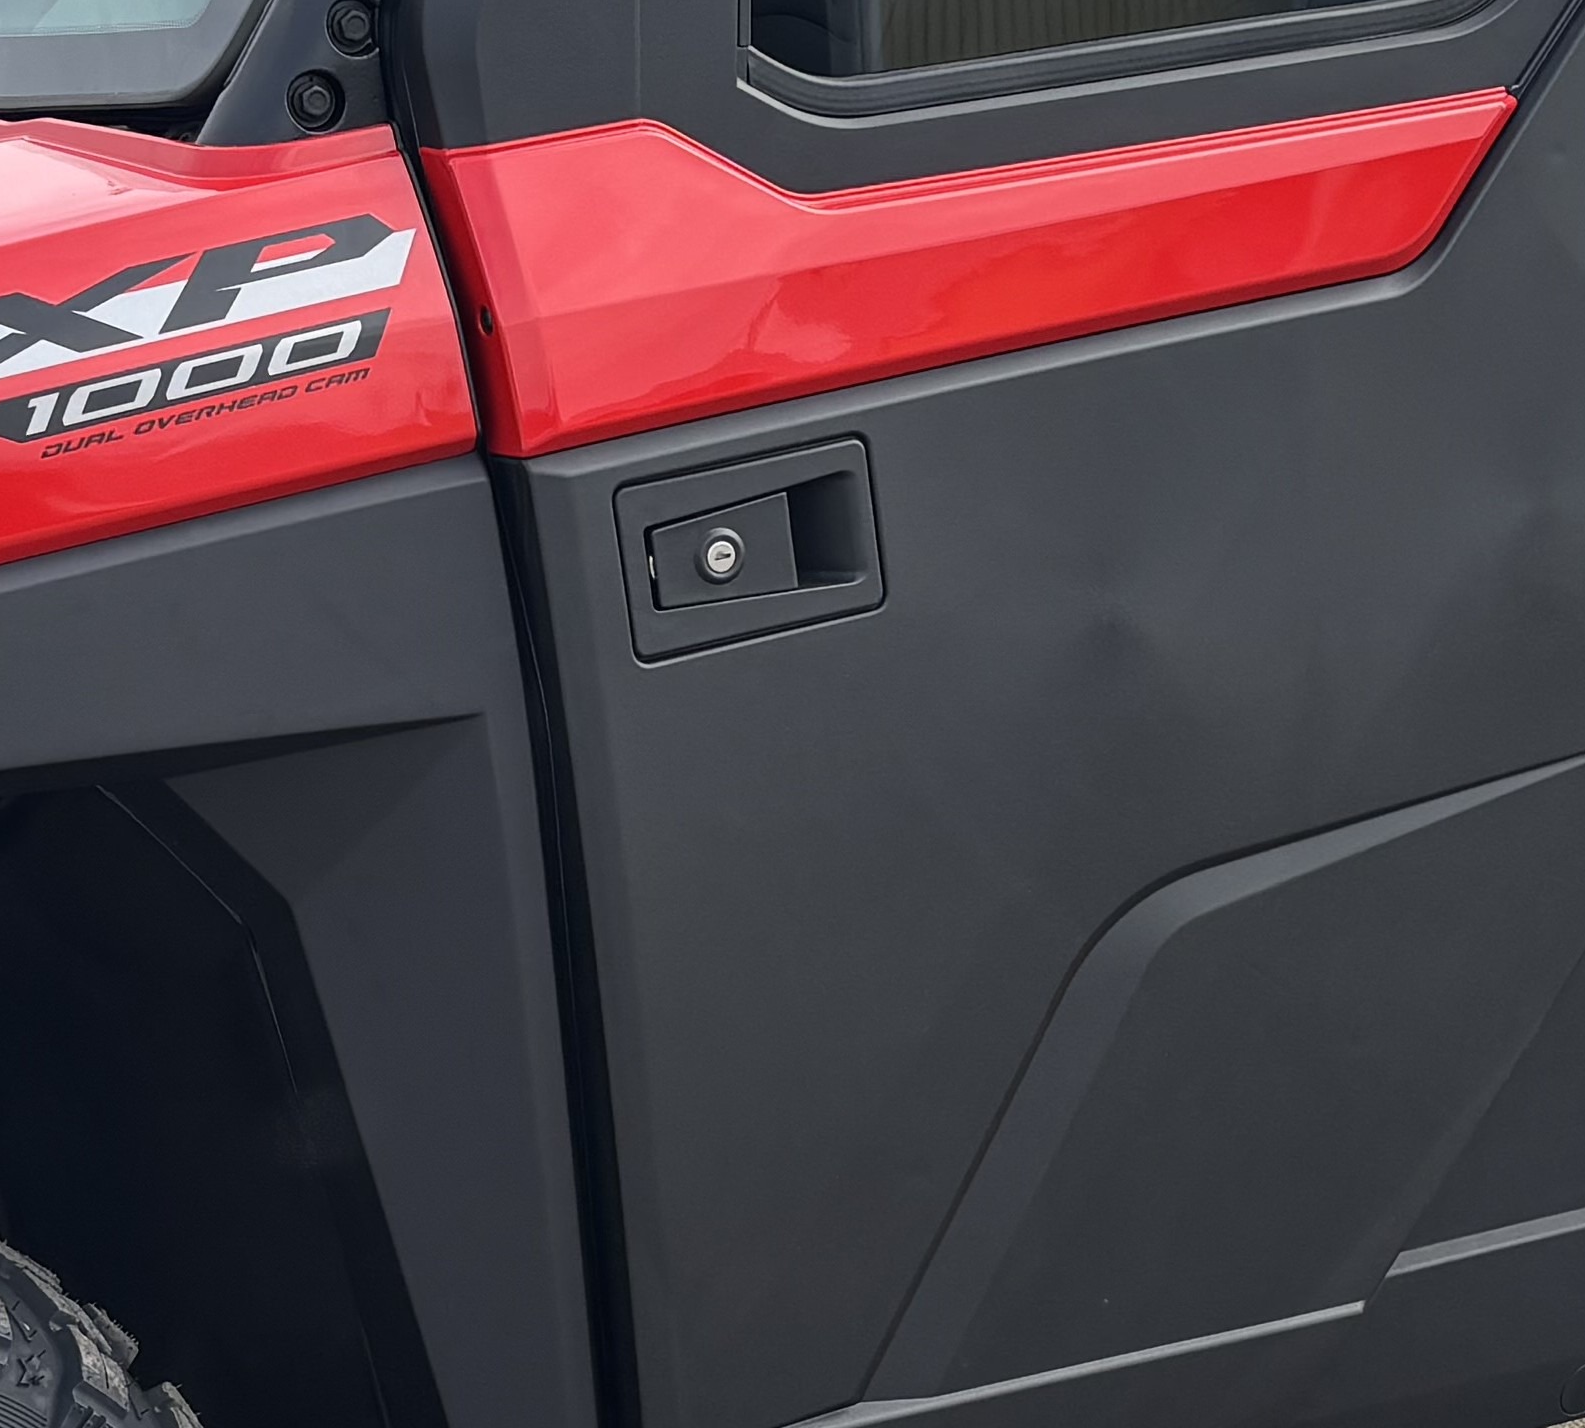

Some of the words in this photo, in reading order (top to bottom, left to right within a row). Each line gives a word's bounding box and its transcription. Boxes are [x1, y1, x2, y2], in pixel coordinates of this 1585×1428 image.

[25, 320, 361, 436] 1000
[40, 429, 123, 459] DUAL
[132, 385, 298, 437] OVERHEAD
[304, 368, 370, 397] CAM
